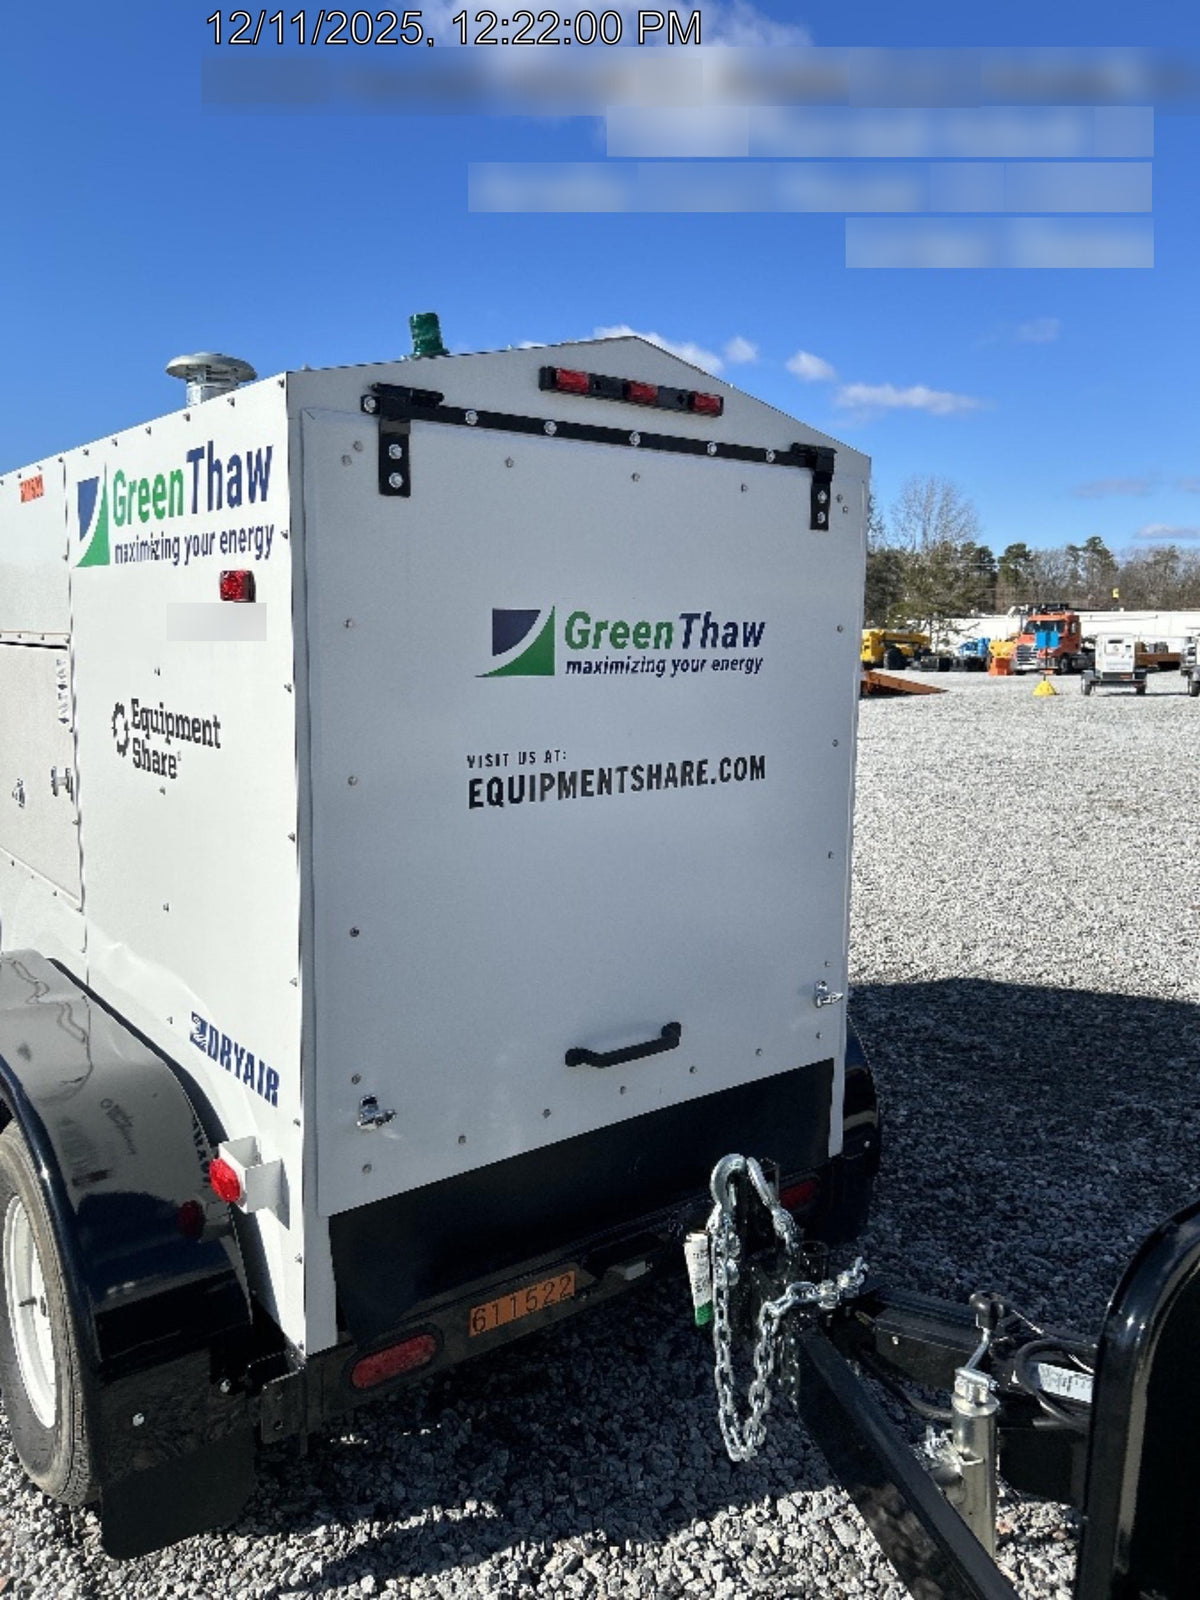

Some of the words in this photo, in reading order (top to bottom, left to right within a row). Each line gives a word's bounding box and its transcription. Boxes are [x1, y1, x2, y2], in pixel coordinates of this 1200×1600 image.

[115, 531, 180, 566] maximizing
[184, 531, 216, 566] your
[220, 524, 275, 561] energy
[565, 656, 666, 677] maximizing
[670, 658, 706, 678] your
[711, 656, 764, 674] energy
[131, 698, 221, 749] Equipment
[132, 737, 178, 779] Share
[467, 753, 509, 769] VISIT
[518, 751, 536, 764] US
[544, 750, 567, 763] AT:
[468, 754, 766, 809] EQUIPMENTSHARE.COM
[207, 1023, 279, 1108] DRYAIR
[472, 1274, 571, 1332] 611522
